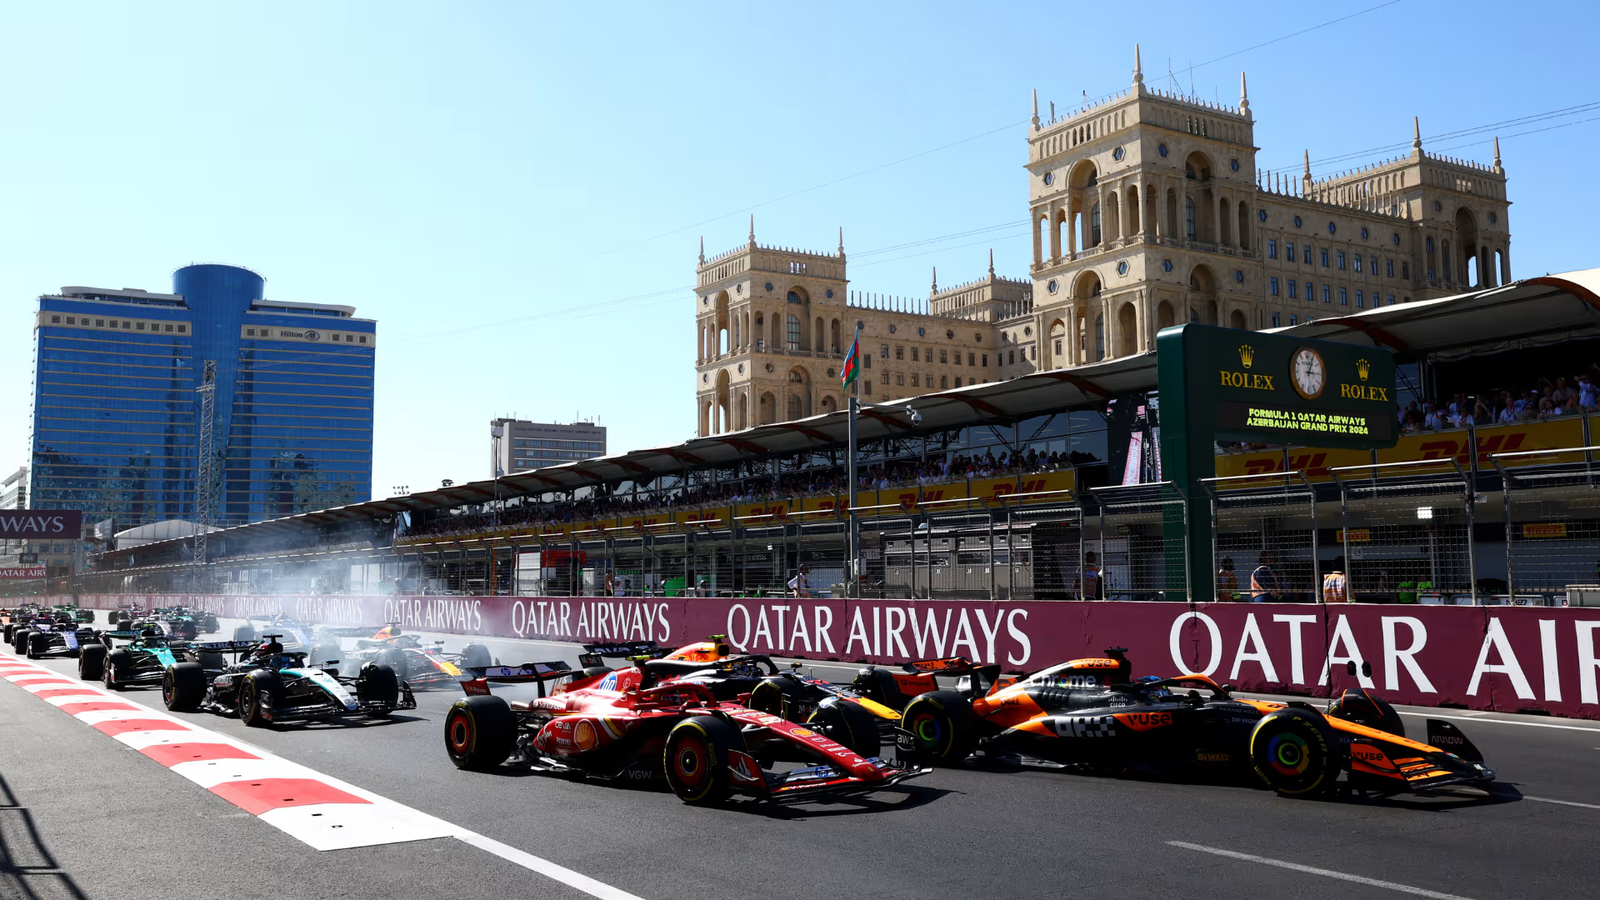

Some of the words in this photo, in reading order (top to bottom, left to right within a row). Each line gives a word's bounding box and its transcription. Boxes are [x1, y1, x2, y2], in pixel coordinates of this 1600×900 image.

[280, 330, 303, 338] Hilton
[1220, 371, 1274, 390] ROLEX
[1340, 384, 1389, 401] ROLEX
[1246, 417, 1299, 430] AZERBAIJAN
[1300, 422, 1328, 432] GRAND
[1329, 424, 1347, 433] PRIX
[1349, 426, 1369, 435] 2024
[1248, 408, 1289, 420] FORMULA
[1291, 412, 1296, 420] 1
[1298, 413, 1326, 423] QATAR
[1328, 415, 1365, 426] AIRWAYS
[1419, 433, 1529, 464] DHL
[1242, 453, 1332, 482] DHL
[898, 490, 946, 509] DHL
[993, 480, 1048, 504] DHL
[687, 513, 717, 527] DHL
[751, 505, 787, 522] DHL
[0, 516, 64, 533] WAYS
[0, 568, 25, 577] ATAR
[296, 598, 323, 622] QATAR
[324, 598, 362, 623] AIRWAYS
[384, 599, 423, 628] QATAR
[424, 599, 481, 631] AIRWAYS
[512, 600, 572, 638] QATAR
[577, 602, 671, 643] AIRWAYS
[727, 603, 837, 655] QATAR
[846, 606, 1032, 666] AIRWAYS
[1169, 611, 1438, 694] QATAR
[1000, 698, 1021, 706] DELL
[555, 721, 571, 729] CEVA
[897, 734, 915, 745] aws
[628, 769, 652, 780] VGW
